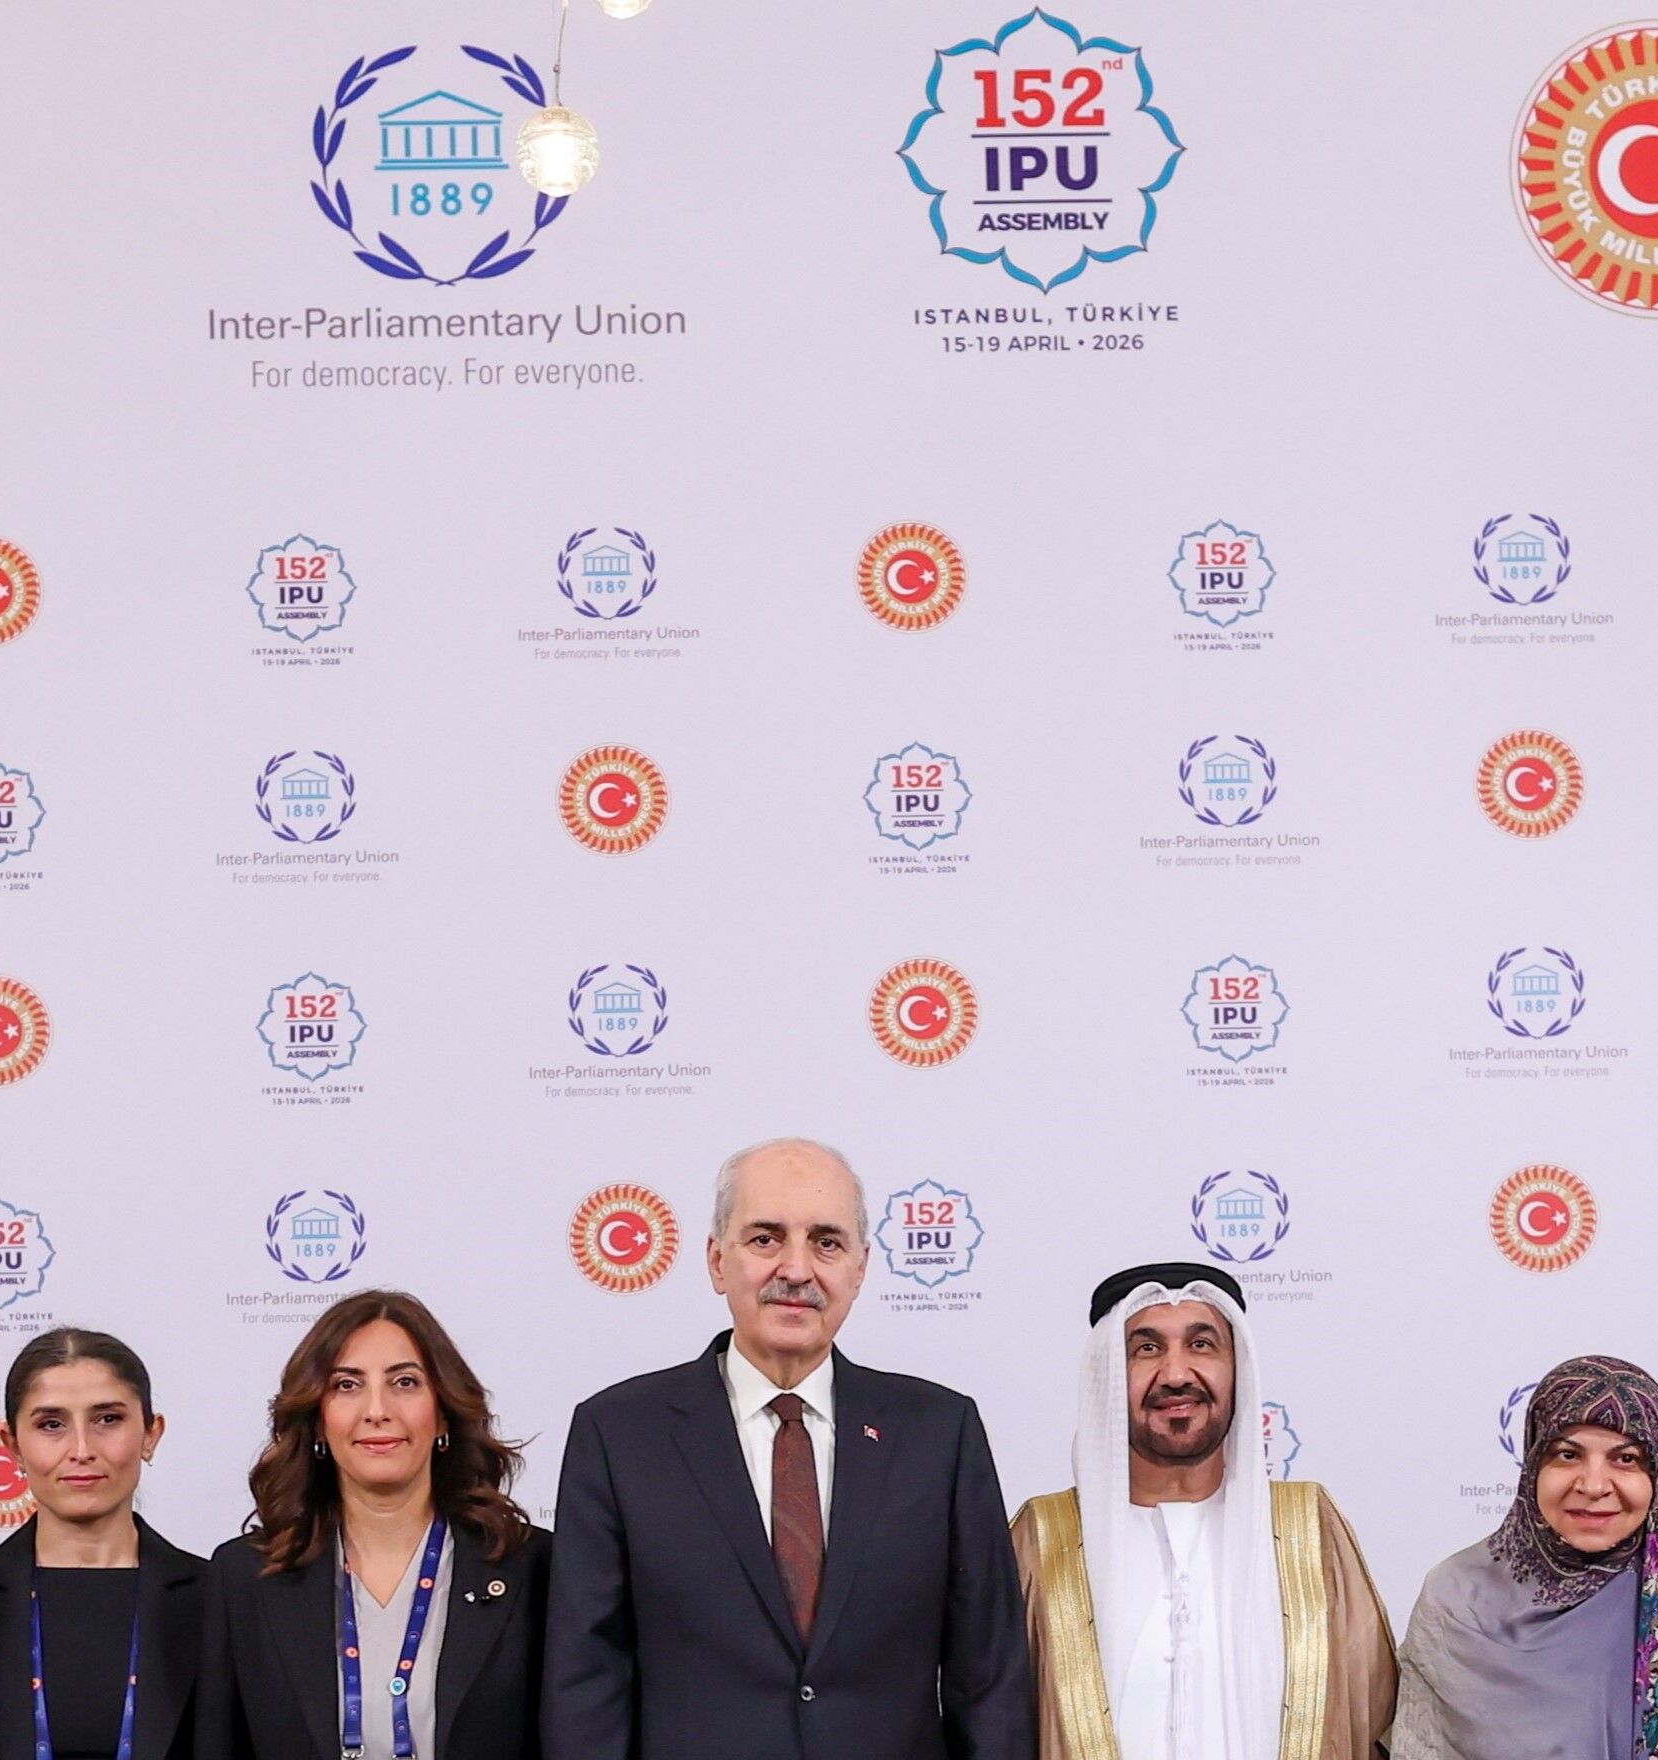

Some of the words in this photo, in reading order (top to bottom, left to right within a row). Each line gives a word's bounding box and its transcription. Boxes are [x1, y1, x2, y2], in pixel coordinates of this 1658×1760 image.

[973, 67, 1105, 128] 152
[1102, 57, 1123, 71] nd
[984, 145, 1099, 192] IPU
[1562, 126, 1601, 233] BÜYÜK
[391, 183, 493, 217] 1889
[977, 211, 1110, 232] ASSEMBLY
[915, 307, 1053, 326] ISTANBUL,
[1066, 302, 1179, 323] TÜRKİYE
[208, 306, 562, 343] Inter-Parliamentary
[575, 304, 686, 336] Union
[942, 336, 1000, 353] 15-19
[1008, 335, 1070, 352] APRIL
[1093, 334, 1144, 351] 2026
[252, 361, 292, 388] For
[302, 359, 452, 392] democracy.
[464, 358, 503, 386] For
[514, 360, 644, 390] everyone.
[1195, 542, 1248, 568] 152
[275, 556, 327, 582] 152
[1503, 566, 1542, 580] 1889
[587, 580, 626, 594] 1889
[1200, 572, 1243, 590] IPU
[280, 586, 323, 604] IPU
[1198, 597, 1247, 605] ASSEMBLY
[1435, 613, 1567, 628] Inter-Parliamentary
[1571, 612, 1614, 625] Union
[518, 628, 653, 642] Inter-Parliamentary
[656, 626, 700, 639] Union
[584, 762, 637, 781] TÜRKİYE
[891, 764, 943, 790] 152
[896, 794, 939, 812] IPU
[1208, 787, 1247, 802] 1889
[286, 804, 326, 818] 1889
[894, 820, 943, 828] ASSEMBLY
[1140, 835, 1273, 849] Inter-Parliamentary
[1277, 833, 1320, 847] Union
[216, 852, 352, 866] Inter-Parliamentary
[355, 850, 399, 863] Union
[1208, 977, 1261, 1003] 152
[284, 994, 337, 1021] 152
[1517, 999, 1556, 1013] 1889
[598, 1017, 638, 1031] 1889
[1214, 1007, 1257, 1025] IPU
[290, 1024, 333, 1043] IPU
[1211, 1032, 1261, 1040] ASSEMBLY
[287, 1050, 337, 1058] ASSEMBLY
[1449, 1047, 1582, 1061] Inter-Parliamentary
[1585, 1045, 1629, 1058] Union
[529, 1065, 664, 1079] Inter-Parliamentary
[668, 1063, 711, 1077] Union
[545, 1085, 561, 1098] For
[625, 1084, 642, 1096] For
[595, 1200, 648, 1219] TÜRKİYE
[902, 1201, 955, 1228] 152
[1221, 1223, 1260, 1237] 1889
[908, 1231, 951, 1250] IPU
[296, 1243, 336, 1257] 1889
[905, 1257, 955, 1265] ASSEMBLY
[1290, 1269, 1333, 1282] Union
